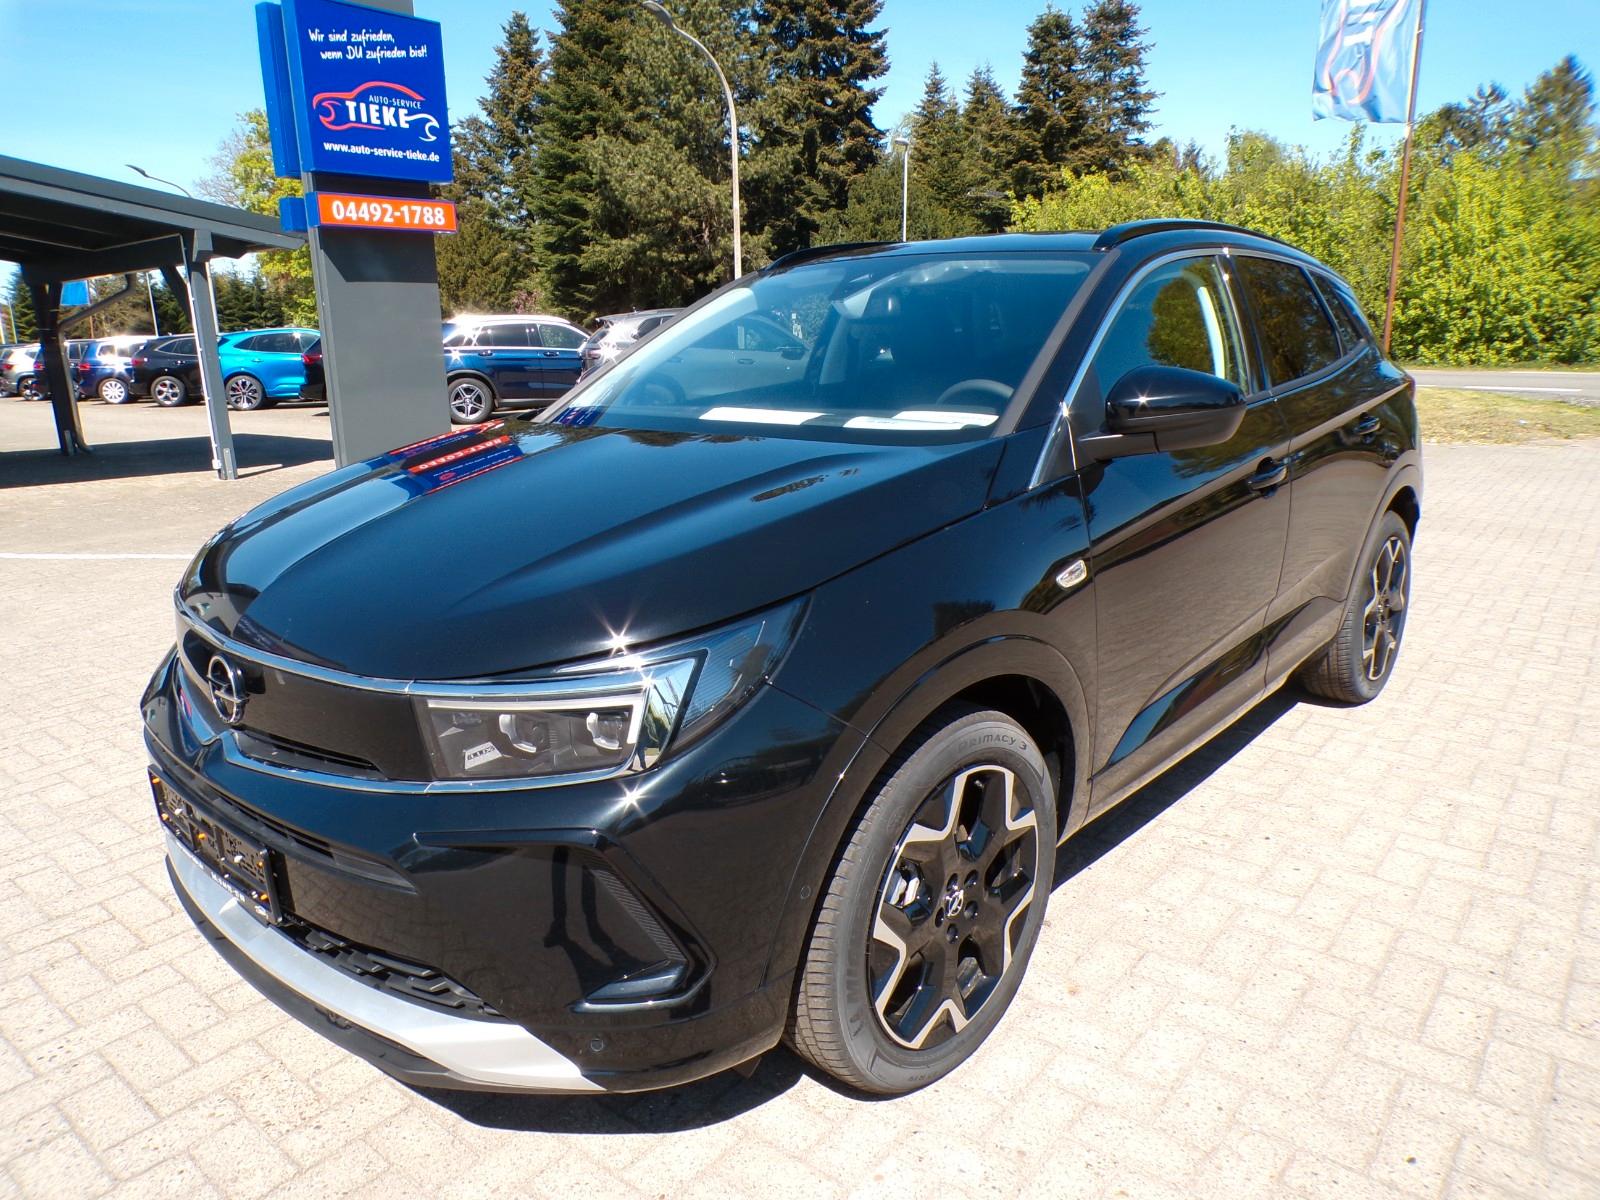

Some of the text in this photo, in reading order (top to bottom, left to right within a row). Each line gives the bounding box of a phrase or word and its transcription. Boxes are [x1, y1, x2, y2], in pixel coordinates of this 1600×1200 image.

[309, 29, 395, 47] Wir sind zufrieden,
[320, 45, 428, 64] wenn DU zufrieden bist!
[368, 94, 422, 110] AUTO-SERVICE
[346, 101, 410, 128] TIEKE
[323, 142, 440, 162] www.auto-service-tieke.de
[332, 201, 445, 225] 04492-1788
